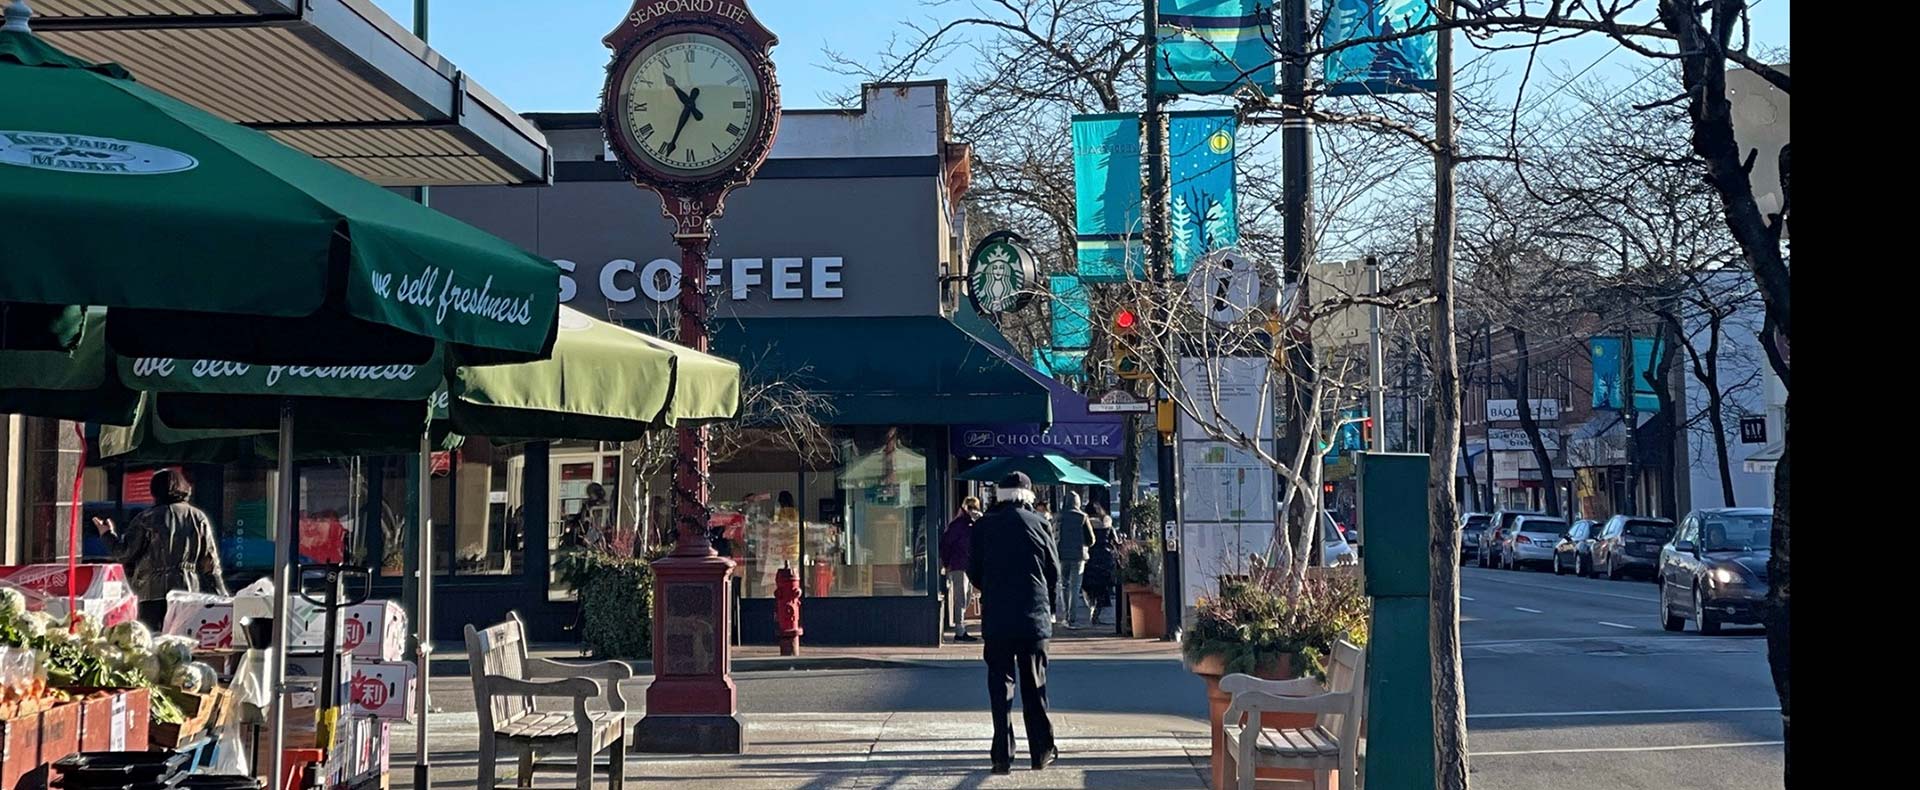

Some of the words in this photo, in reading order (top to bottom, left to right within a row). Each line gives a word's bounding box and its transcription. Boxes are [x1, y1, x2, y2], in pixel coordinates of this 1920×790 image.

[629, 0, 713, 27] SEABOARD
[716, 1, 749, 25] LIFE
[681, 216, 702, 228] AD
[371, 269, 392, 299] we
[396, 265, 439, 308] sell
[436, 269, 532, 326] freshness
[1744, 423, 1762, 436] GAP
[996, 433, 1110, 446] CHOCOLATIER
[362, 685, 383, 705] 利
